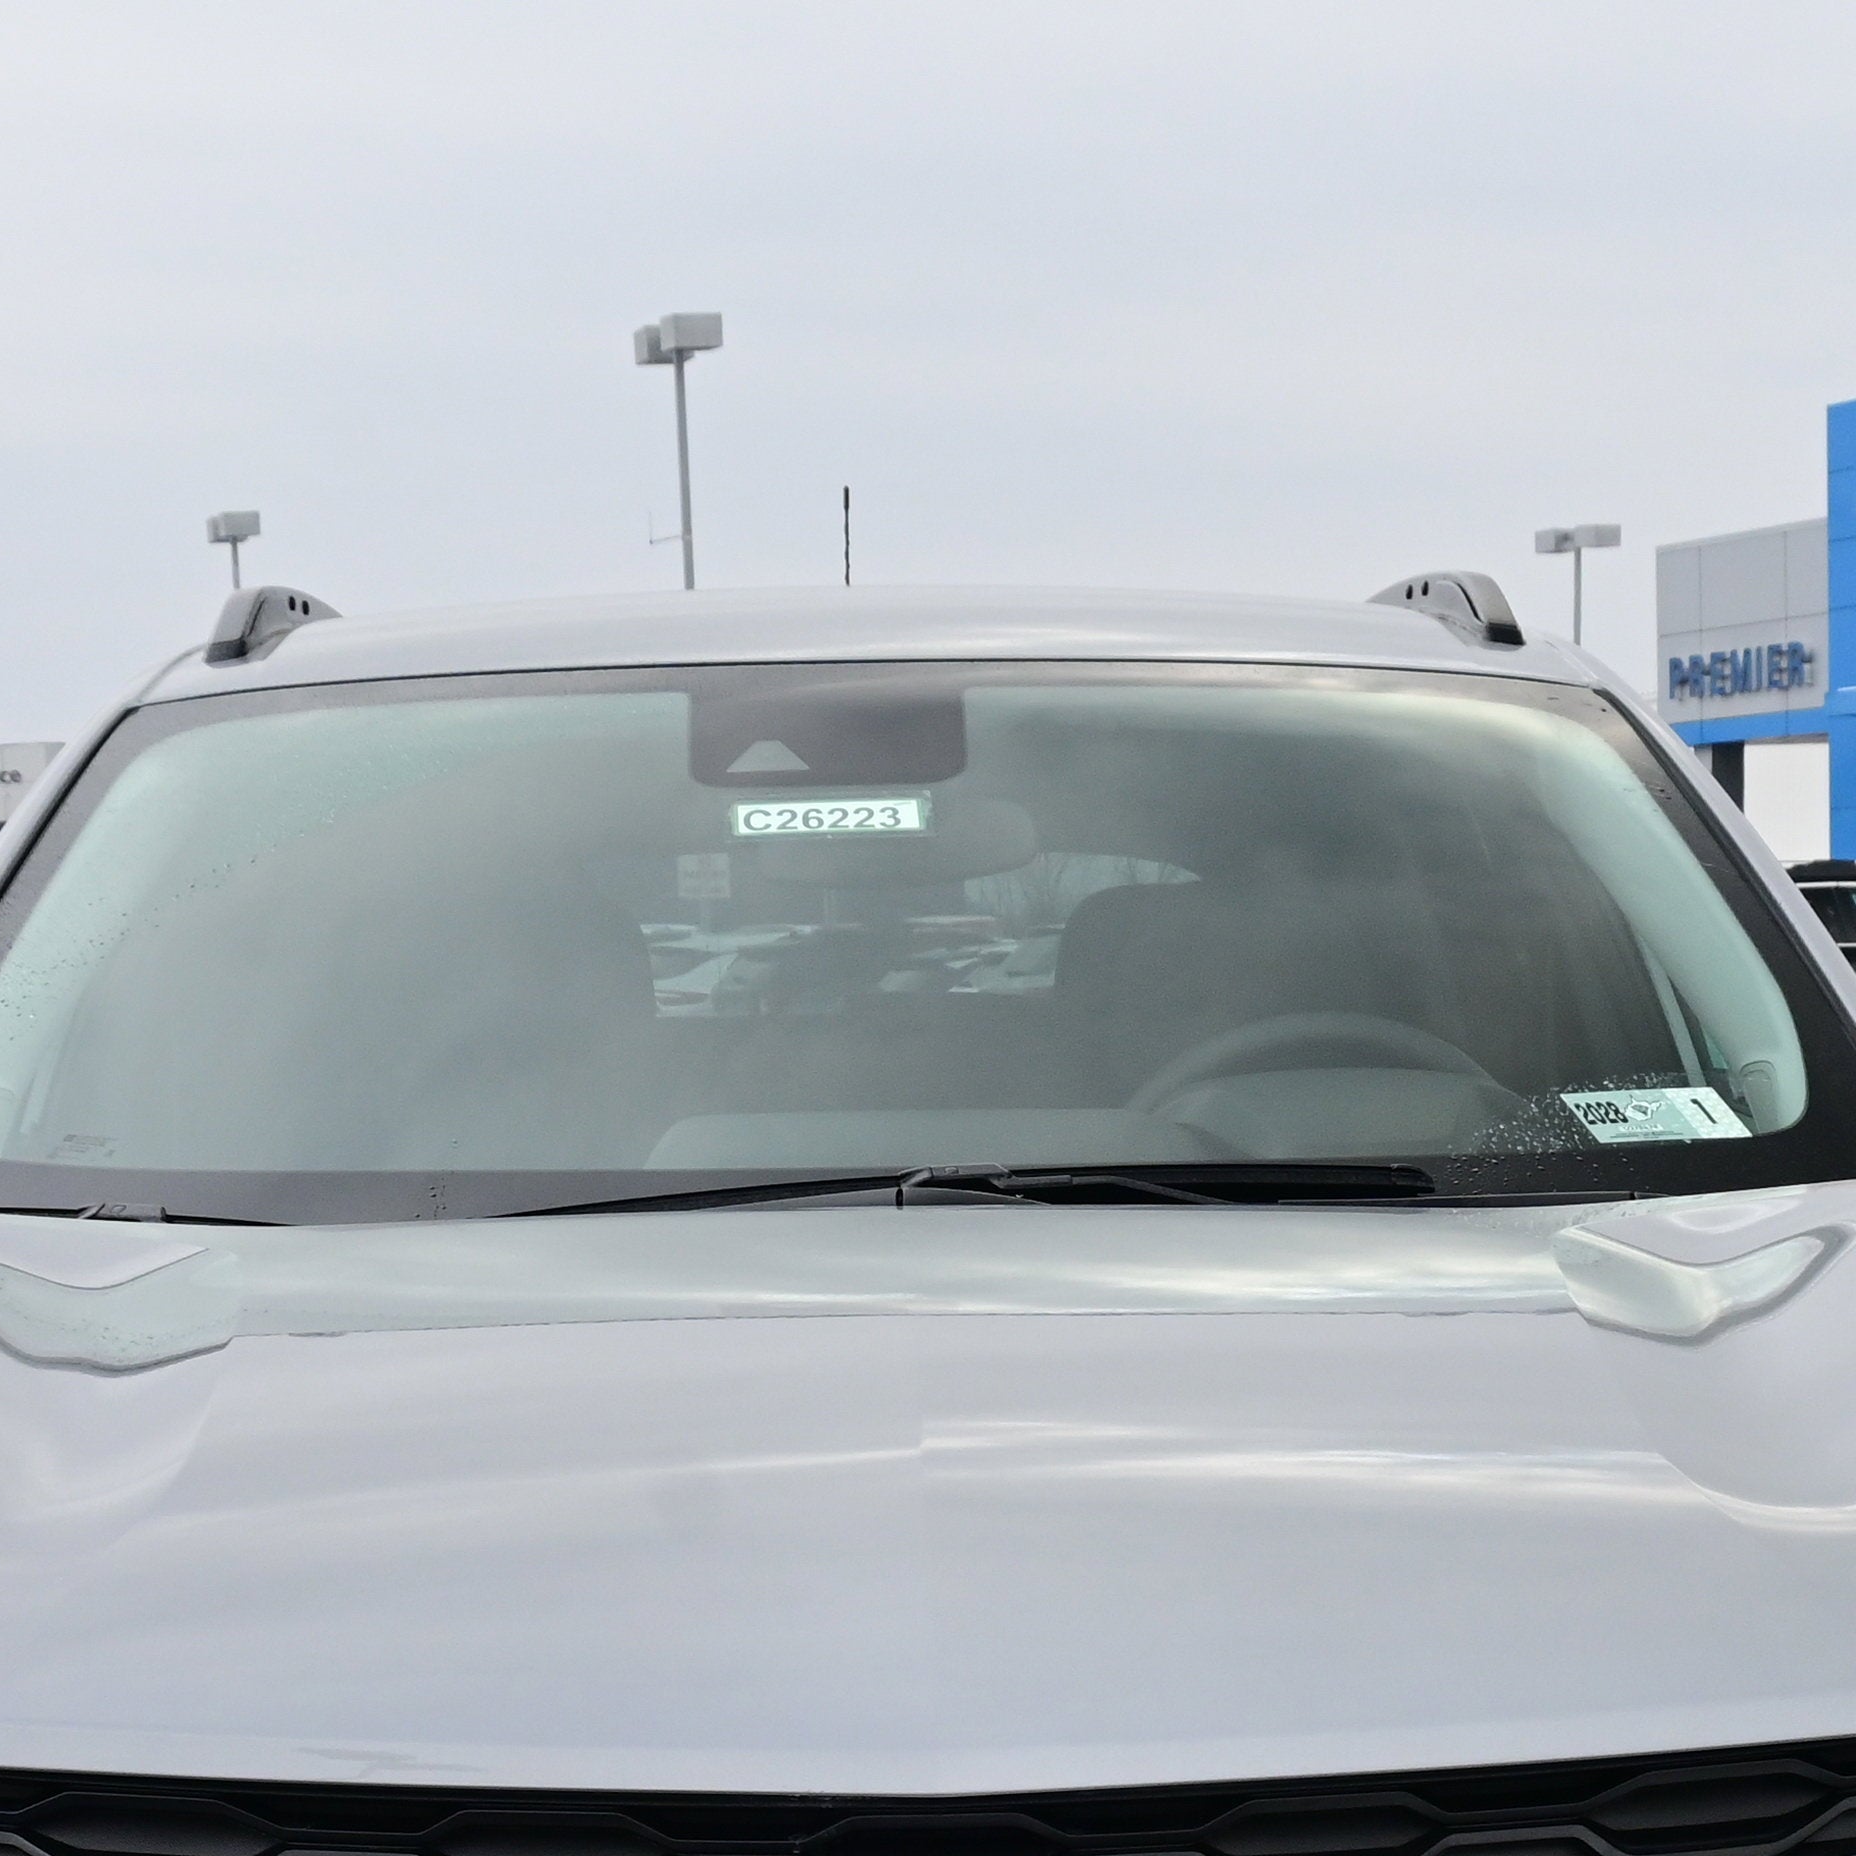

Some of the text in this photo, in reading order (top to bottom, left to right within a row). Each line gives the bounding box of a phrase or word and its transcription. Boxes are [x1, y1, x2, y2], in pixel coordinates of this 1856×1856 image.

[1669, 641, 1812, 701] PREMIER
[743, 806, 902, 832] C26223
[1573, 1098, 1718, 1125] 2028 1
